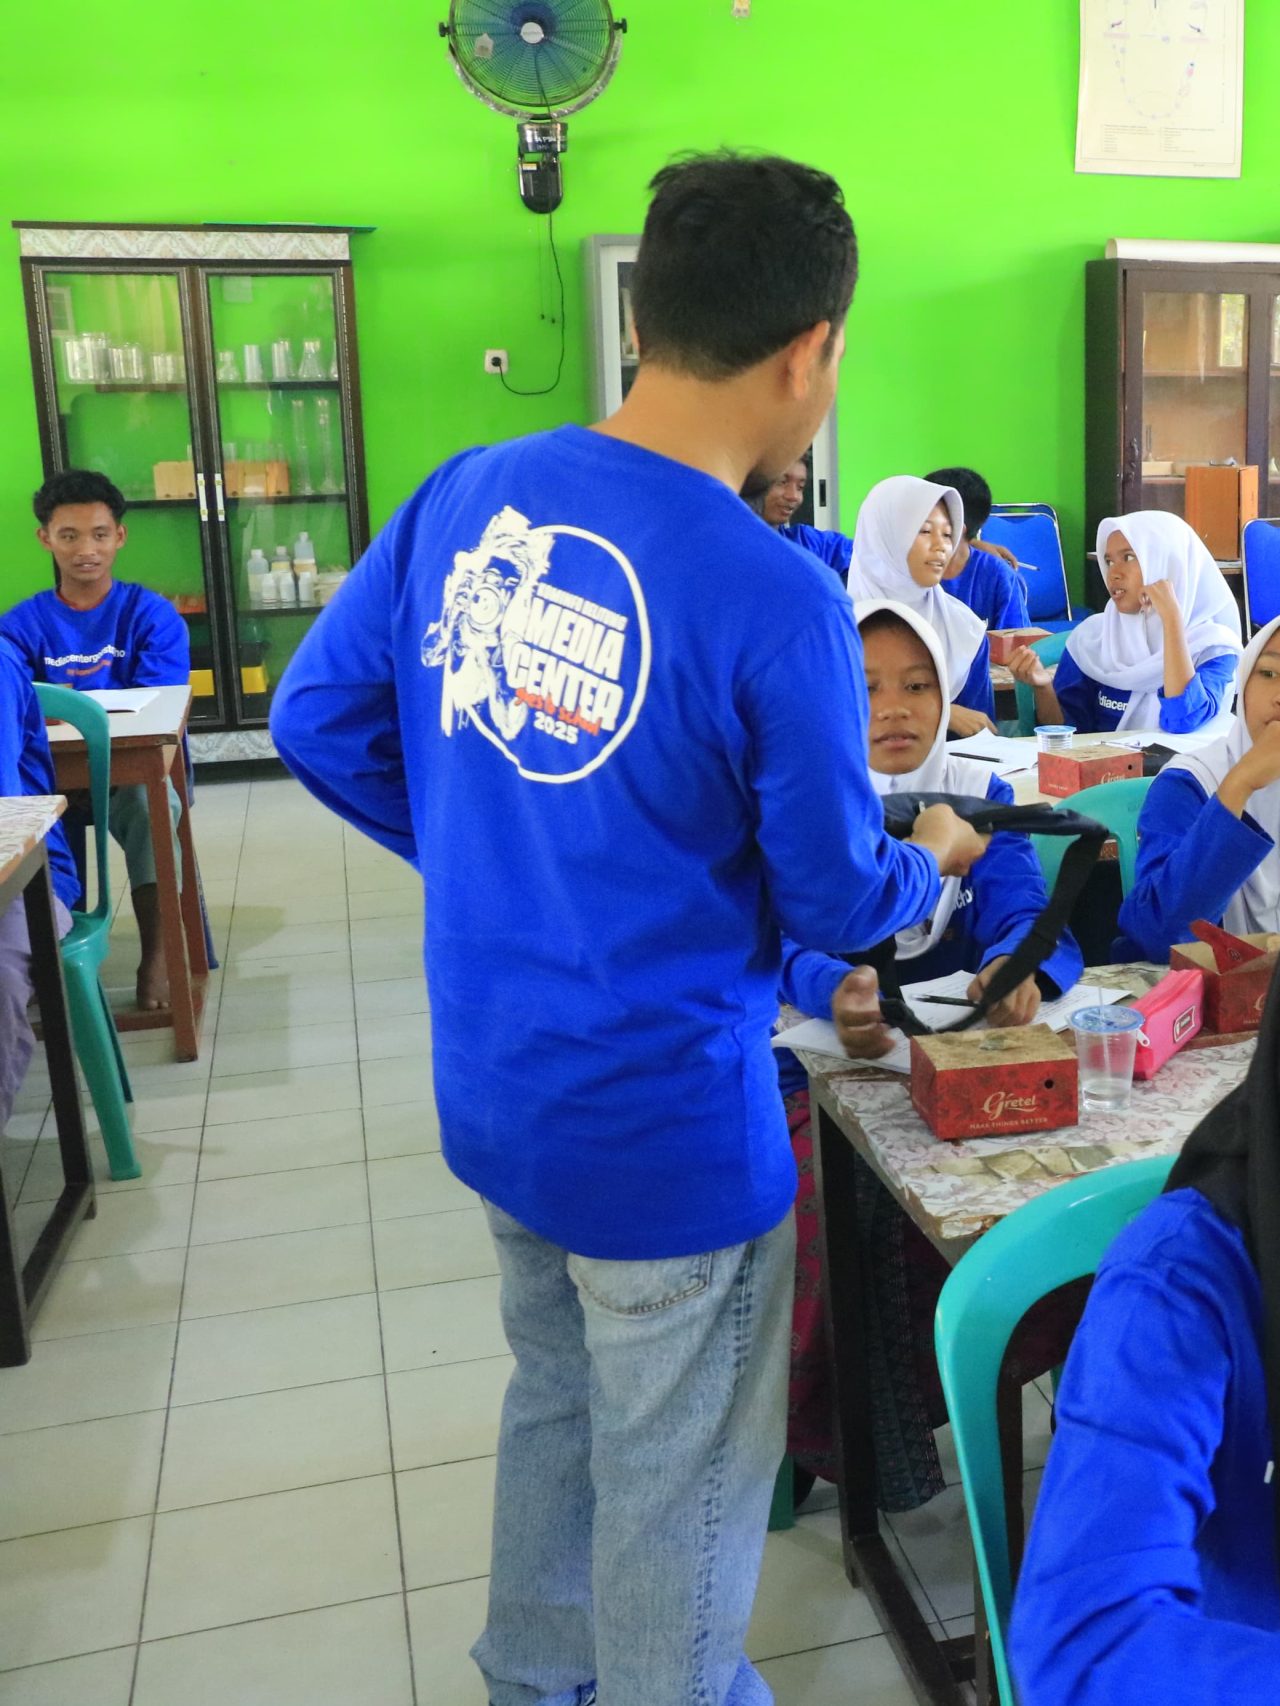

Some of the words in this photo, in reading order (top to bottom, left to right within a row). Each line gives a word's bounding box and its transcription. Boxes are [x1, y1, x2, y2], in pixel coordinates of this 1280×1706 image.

[523, 596, 626, 681] MEDIA
[507, 642, 624, 731] CENTER
[533, 711, 579, 744] 2025
[981, 1091, 1038, 1120] Gretel
